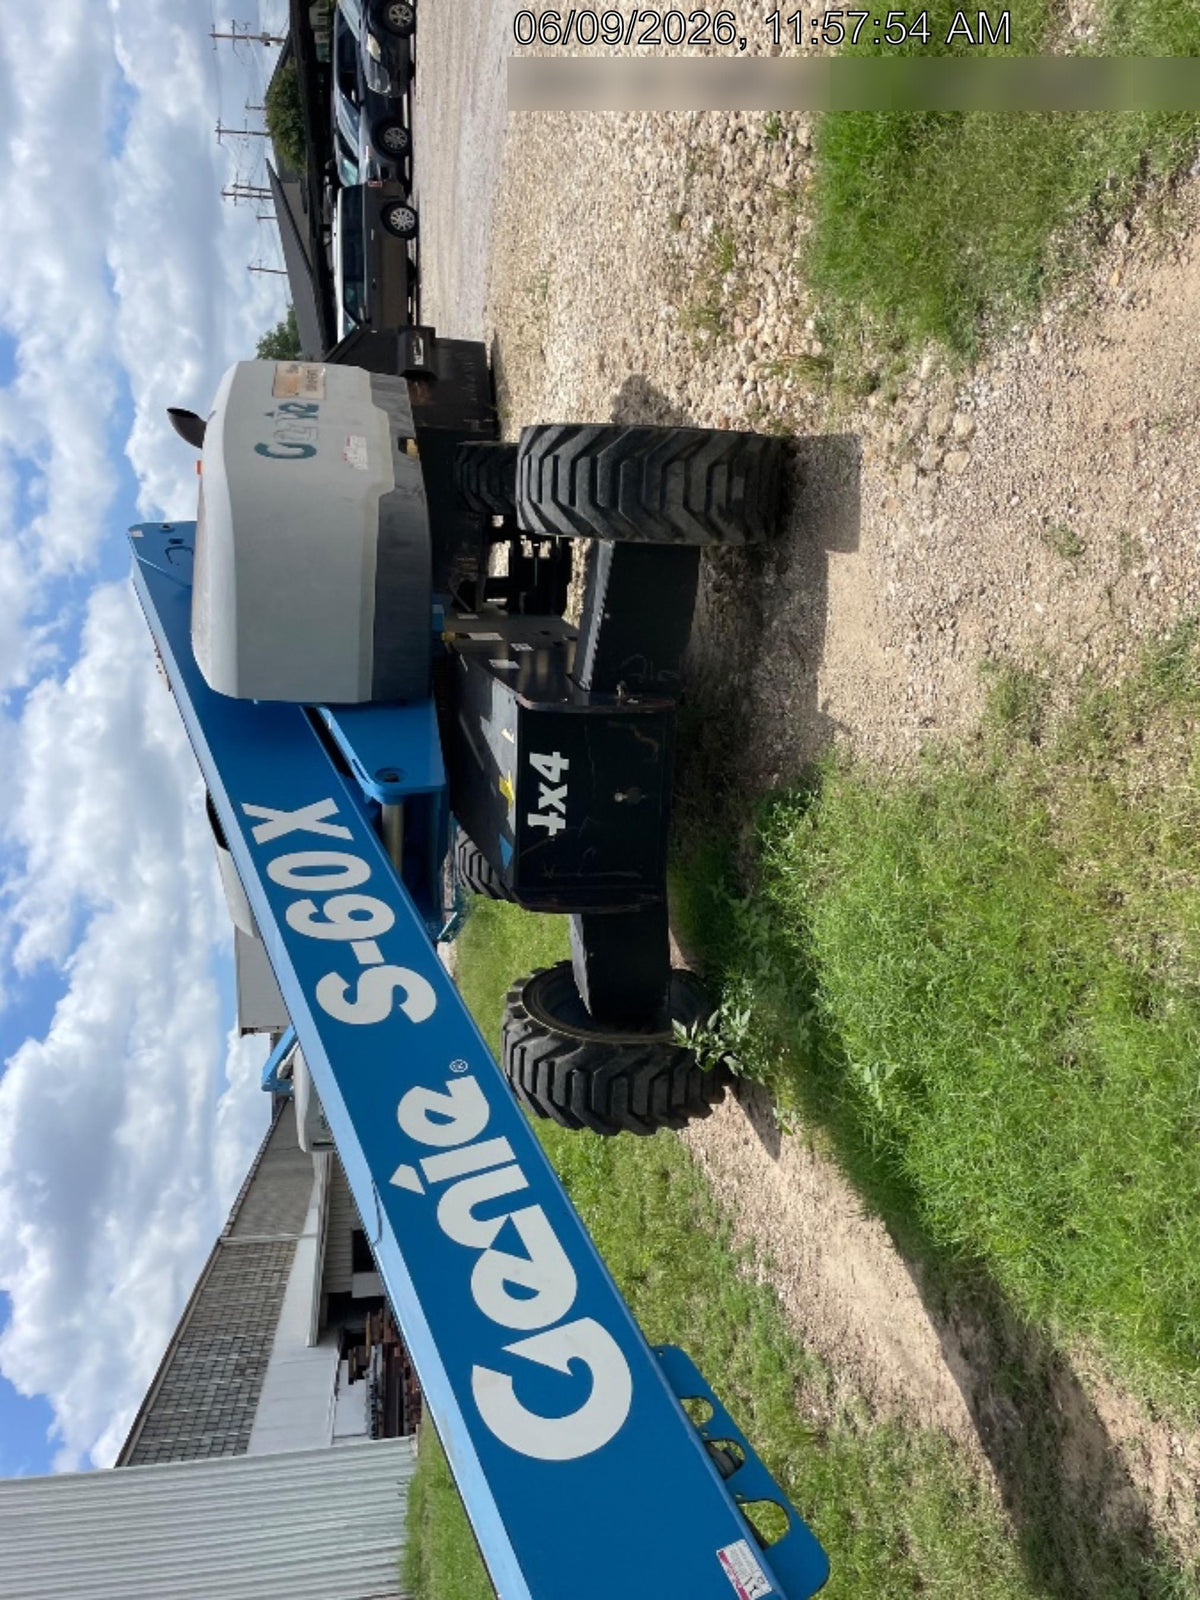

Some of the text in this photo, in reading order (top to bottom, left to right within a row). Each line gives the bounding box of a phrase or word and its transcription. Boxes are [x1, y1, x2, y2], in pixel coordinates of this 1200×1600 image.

[254, 402, 320, 460] Gie
[527, 751, 570, 837] 4x4
[241, 797, 438, 1025] S-60X
